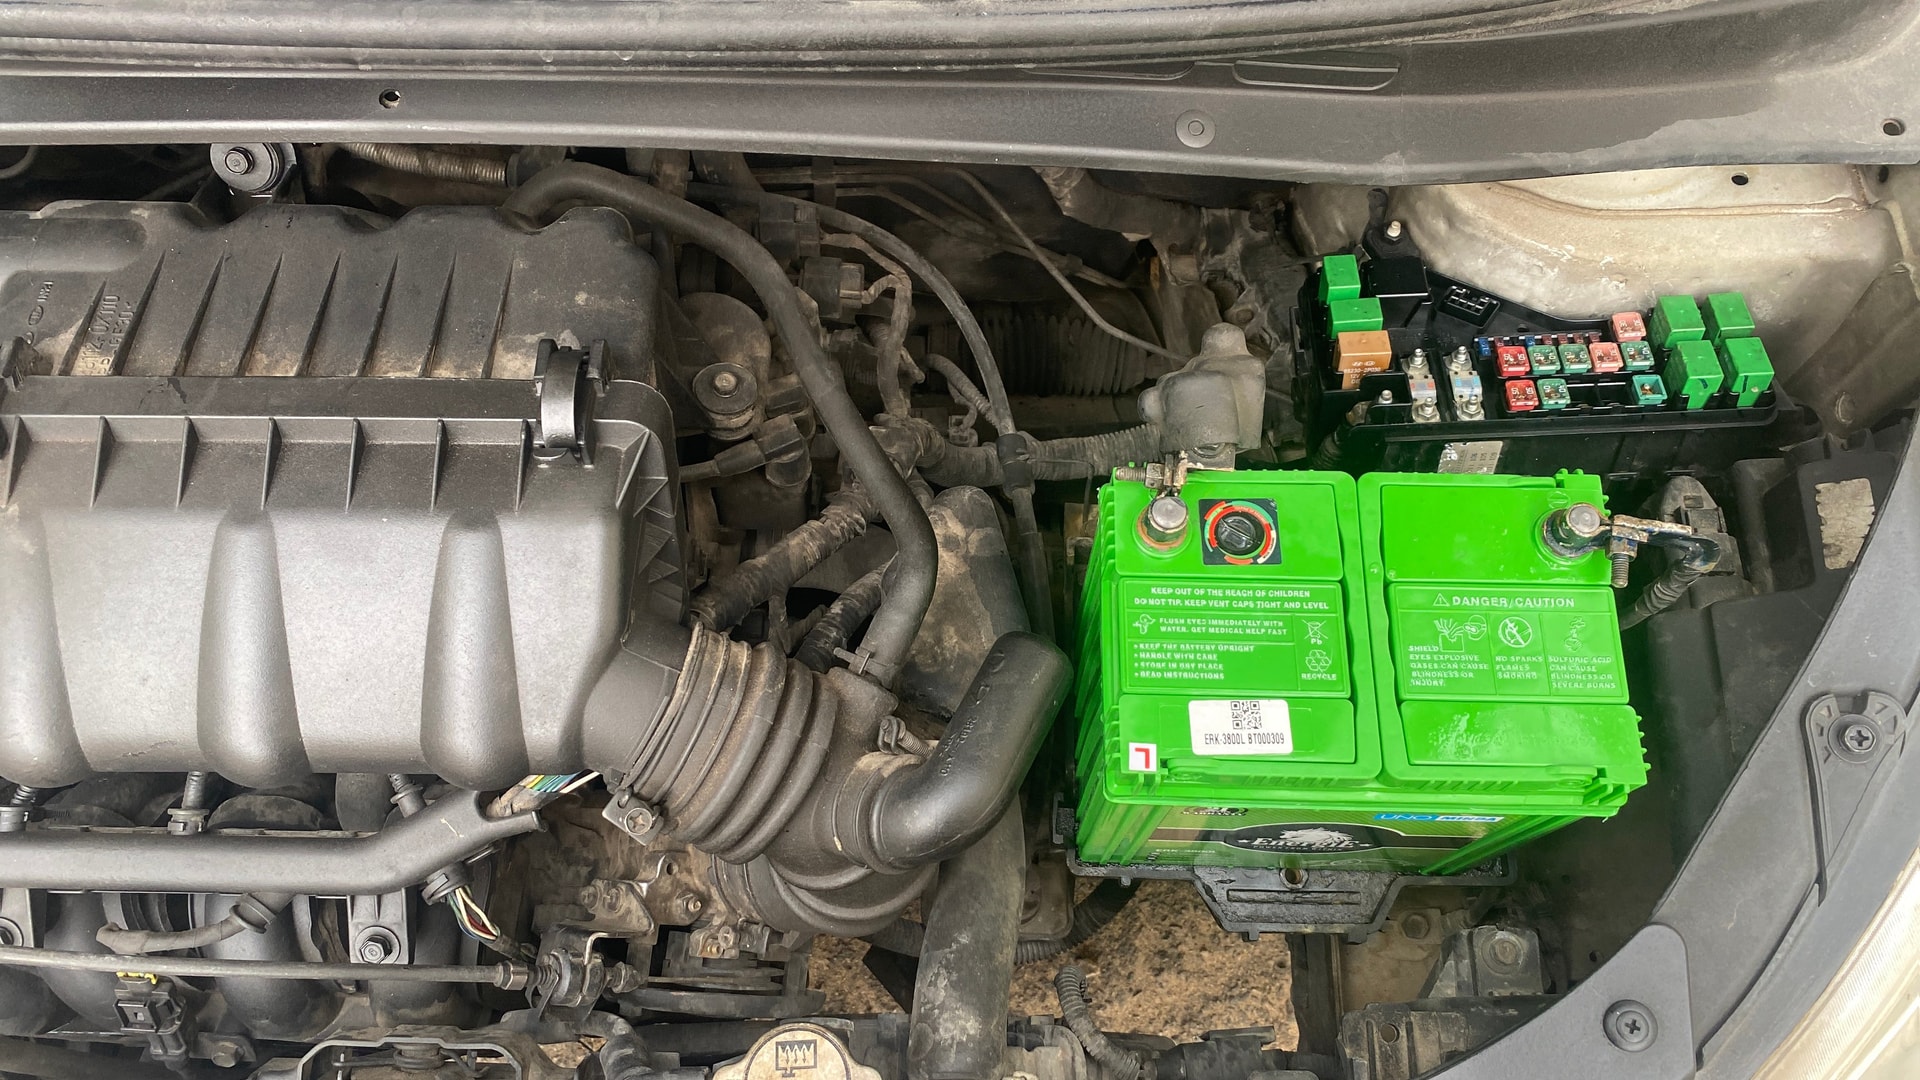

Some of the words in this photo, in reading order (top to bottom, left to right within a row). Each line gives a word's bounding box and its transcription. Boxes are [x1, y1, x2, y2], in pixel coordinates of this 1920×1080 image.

[1151, 587, 1173, 595] KEEP
[1207, 588, 1223, 596] THE
[1225, 589, 1253, 597] REACH
[1268, 590, 1310, 598] CHILDREN
[1134, 597, 1147, 605] DO
[1148, 598, 1166, 606] NOT
[1184, 599, 1207, 607] KEEP
[1208, 600, 1230, 608] VENT
[1232, 600, 1254, 608] CAPS
[1283, 601, 1300, 609] AND
[1452, 596, 1575, 608] DANGER/CAUTION
[1139, 642, 1161, 650] KEEP
[1173, 652, 1194, 660] WITH
[1196, 653, 1218, 661] CARE
[1548, 655, 1590, 663] SULFURIC
[1140, 661, 1166, 669] STORE
[1179, 662, 1196, 670] DRY
[1163, 671, 1225, 679] INSTRUCTIONS
[1204, 732, 1246, 745] ERK-3800L
